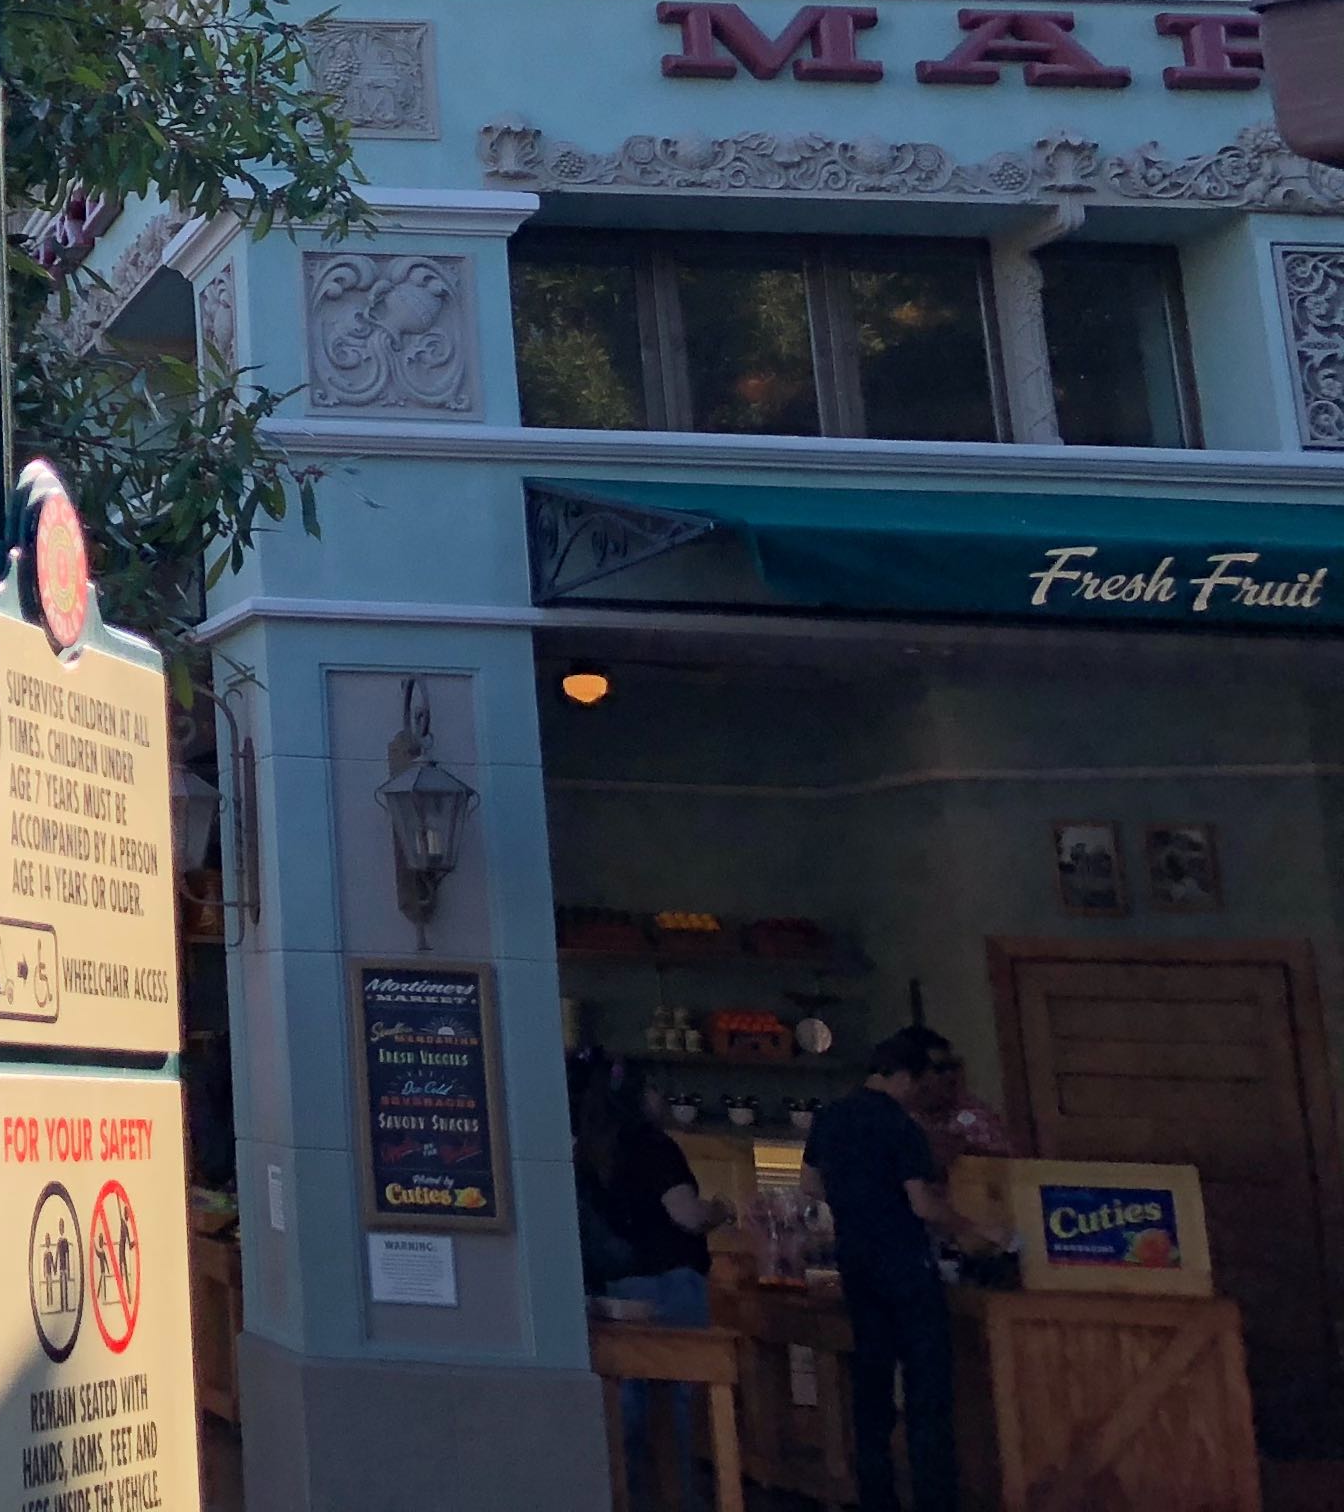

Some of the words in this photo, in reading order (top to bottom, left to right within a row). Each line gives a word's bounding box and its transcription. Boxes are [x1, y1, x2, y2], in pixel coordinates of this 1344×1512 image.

[1029, 546, 1177, 606] Fresh
[1190, 552, 1328, 611] Fruit
[7, 669, 64, 720] SUPERVISE
[67, 691, 116, 737] CHILDREN
[119, 708, 130, 742] AT
[134, 711, 150, 747] ALL
[7, 715, 45, 759] TIMES.
[48, 728, 98, 775] CHILDREN
[100, 744, 135, 785] UNDER
[10, 762, 32, 802] AGE
[35, 769, 42, 804] 7
[45, 772, 80, 814] YEARS
[83, 782, 112, 822] MUST
[114, 791, 128, 826] BE
[11, 809, 90, 861] ACCOMPANIED
[93, 830, 107, 865] BY
[110, 834, 118, 868] A
[119, 835, 159, 876] PERSON
[12, 857, 35, 898] AGE
[38, 863, 51, 900] 14
[54, 865, 89, 907] YEARS
[91, 873, 107, 910] OR
[109, 877, 145, 916] OLDER.
[62, 956, 130, 1000] WHEELCHAIR
[134, 967, 169, 1004] ACCESS
[375, 994, 468, 1004] MARKET
[3, 1116, 40, 1163] FOR
[44, 1116, 94, 1162] YOUR
[99, 1117, 153, 1162] SAFETY
[385, 1183, 452, 1205] Cuties
[1049, 1198, 1162, 1239] Cuties
[30, 1385, 77, 1433] REMAIN
[80, 1378, 118, 1423] SEATED
[120, 1372, 149, 1414] WITH
[22, 1440, 68, 1489] HANDS,
[72, 1431, 108, 1477] ARMS,
[110, 1425, 132, 1467] FEET
[136, 1421, 158, 1462] AND
[94, 1481, 114, 1512] THE
[117, 1470, 162, 1512] VEHICLE.
